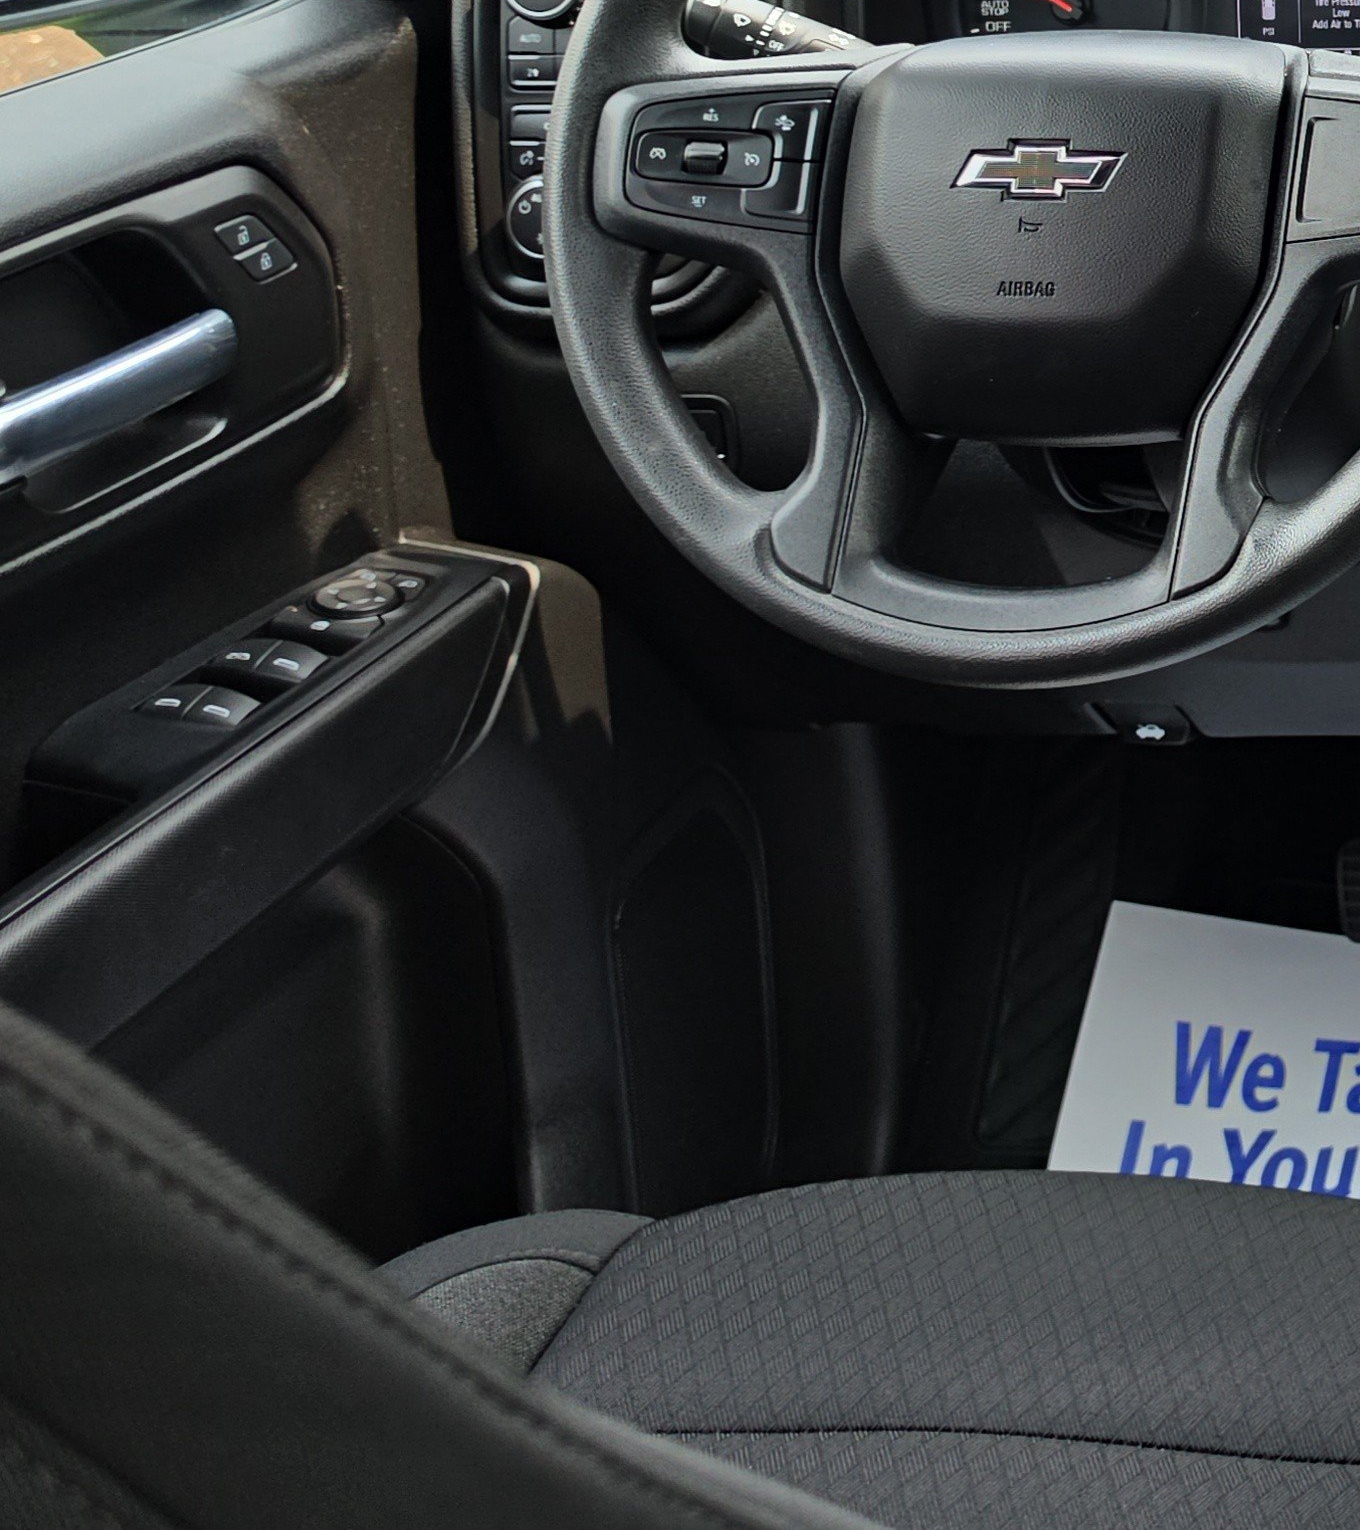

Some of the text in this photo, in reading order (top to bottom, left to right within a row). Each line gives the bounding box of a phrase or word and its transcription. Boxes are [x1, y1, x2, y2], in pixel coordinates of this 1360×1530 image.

[981, 0, 1009, 9] AUTO
[981, 8, 1008, 16] STOP
[1333, 8, 1350, 17] Low
[985, 21, 1011, 32] OFF
[1312, 20, 1328, 29] Add
[1331, 19, 1341, 29] Air
[1344, 20, 1352, 28] to
[769, 40, 784, 51] OFF
[996, 280, 1056, 297] AIRBAG
[1174, 1021, 1285, 1112] We
[1118, 1119, 1192, 1179] In
